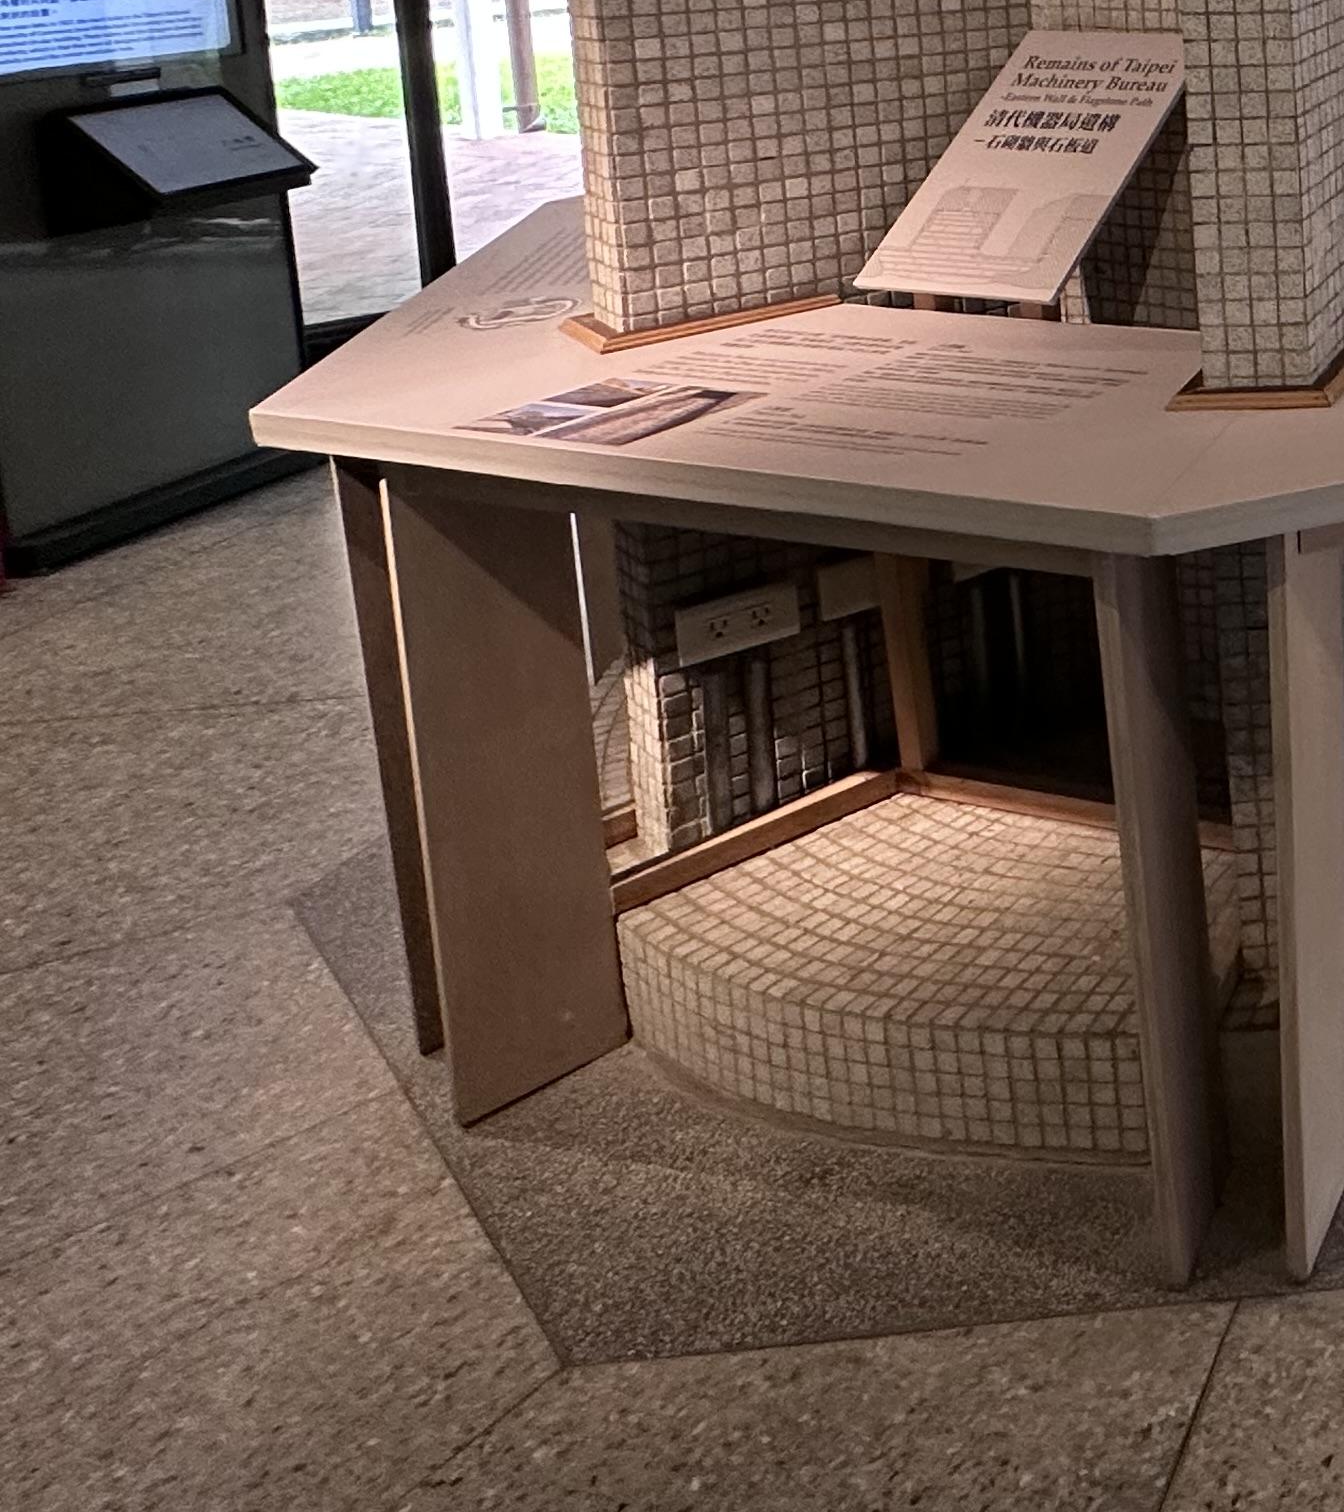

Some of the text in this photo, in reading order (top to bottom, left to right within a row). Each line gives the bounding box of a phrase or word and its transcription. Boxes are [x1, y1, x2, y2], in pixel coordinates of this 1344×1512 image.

[1024, 55, 1178, 78] Remains of Taipei
[1011, 73, 1169, 94] Machinery Bureau
